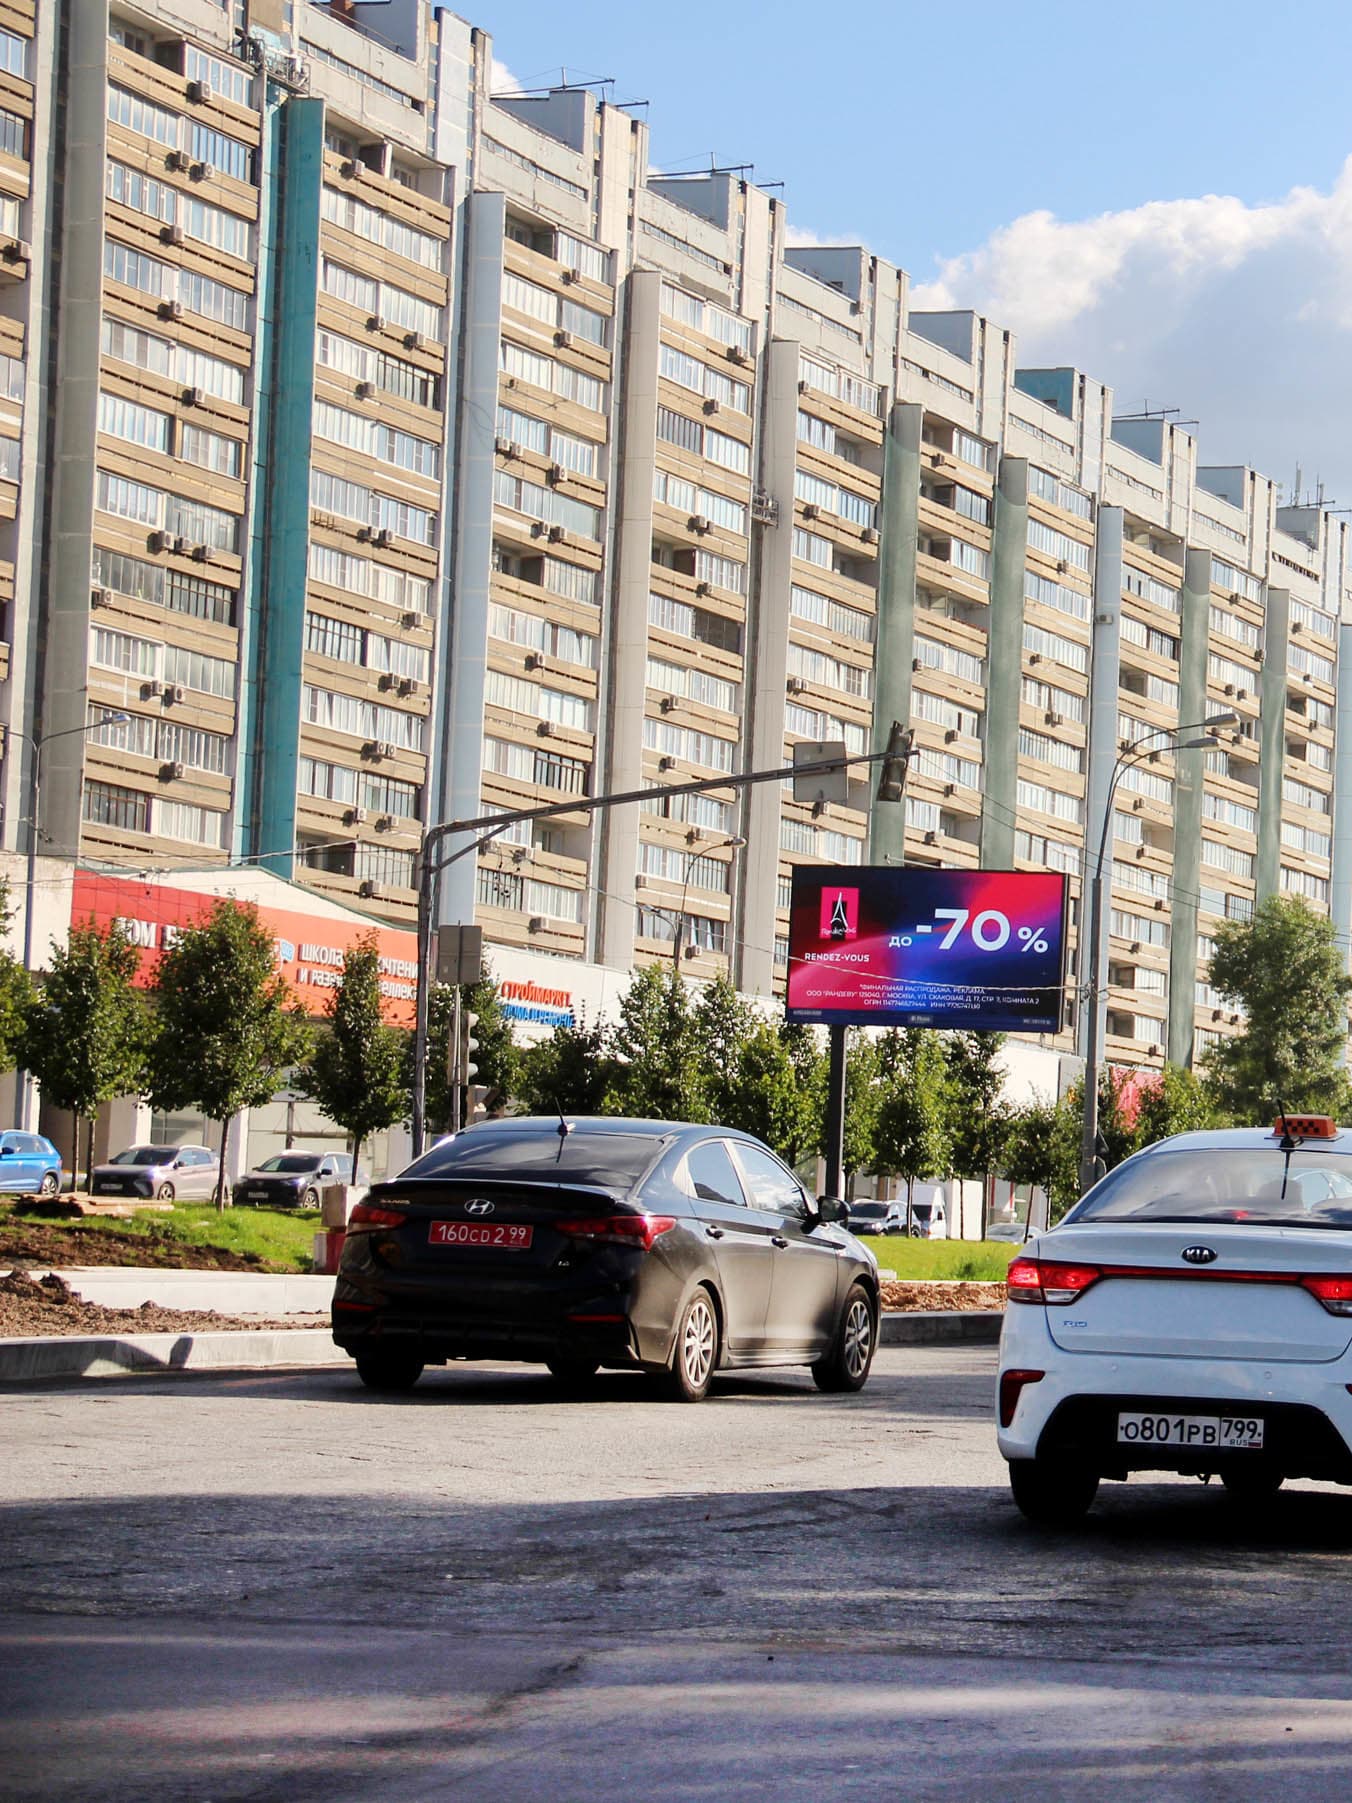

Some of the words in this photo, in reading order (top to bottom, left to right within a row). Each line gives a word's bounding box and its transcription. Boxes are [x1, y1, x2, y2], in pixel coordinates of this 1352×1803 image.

[804, 952, 870, 963] RENDEZ-VOUS
[1186, 1249, 1210, 1260] KIA
[1222, 1419, 1258, 1439] 799
